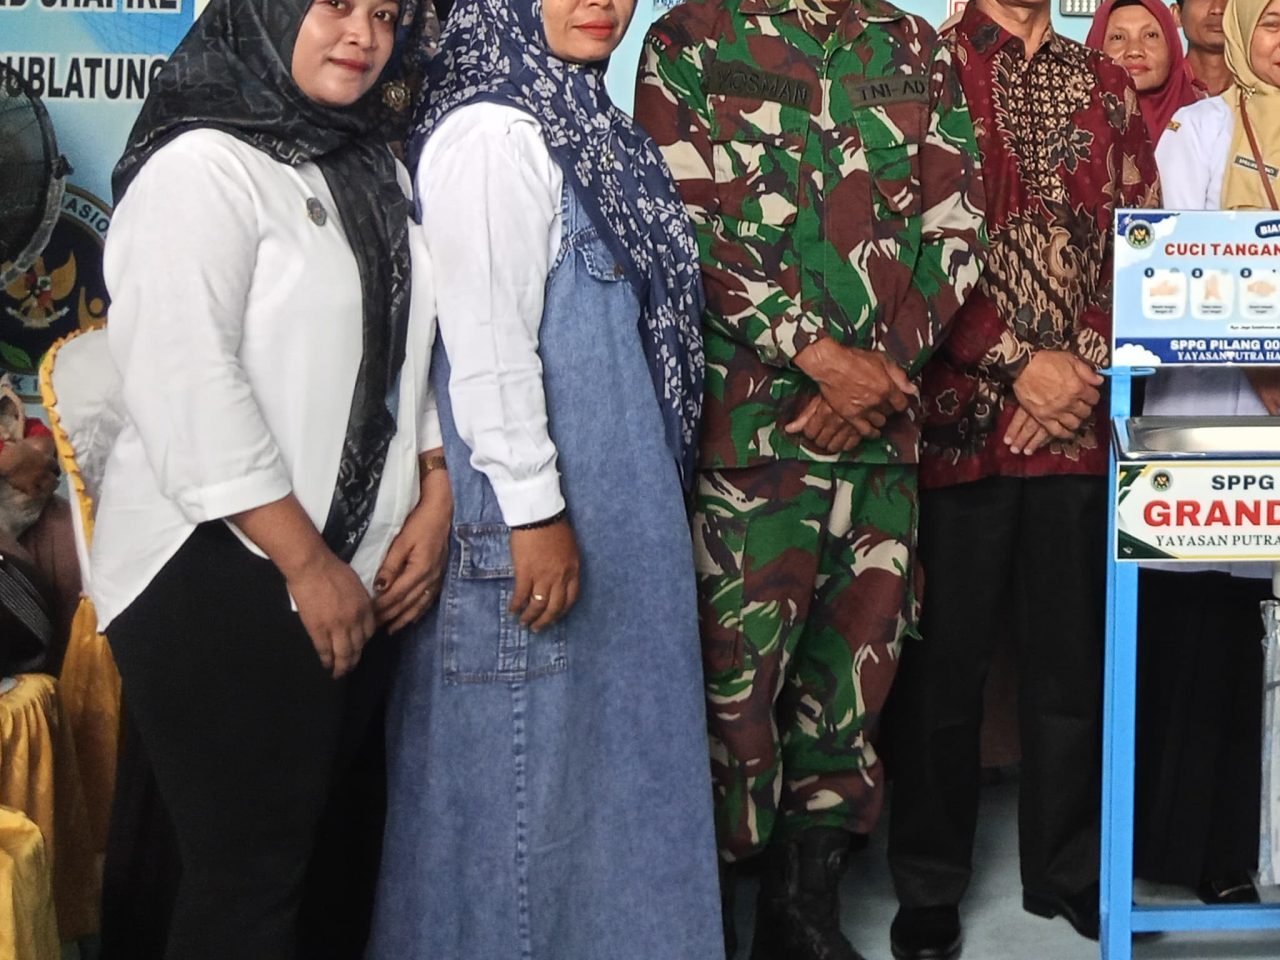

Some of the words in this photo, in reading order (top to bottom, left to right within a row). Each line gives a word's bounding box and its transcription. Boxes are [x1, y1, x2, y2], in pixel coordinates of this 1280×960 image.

[1164, 243, 1206, 256] CUCI
[1170, 340, 1204, 350] SPPG
[1210, 340, 1260, 350] PILANG
[1178, 351, 1227, 361] YAYASAN
[1211, 475, 1275, 491] SPPG
[1156, 535, 1229, 547] YAYASAN
